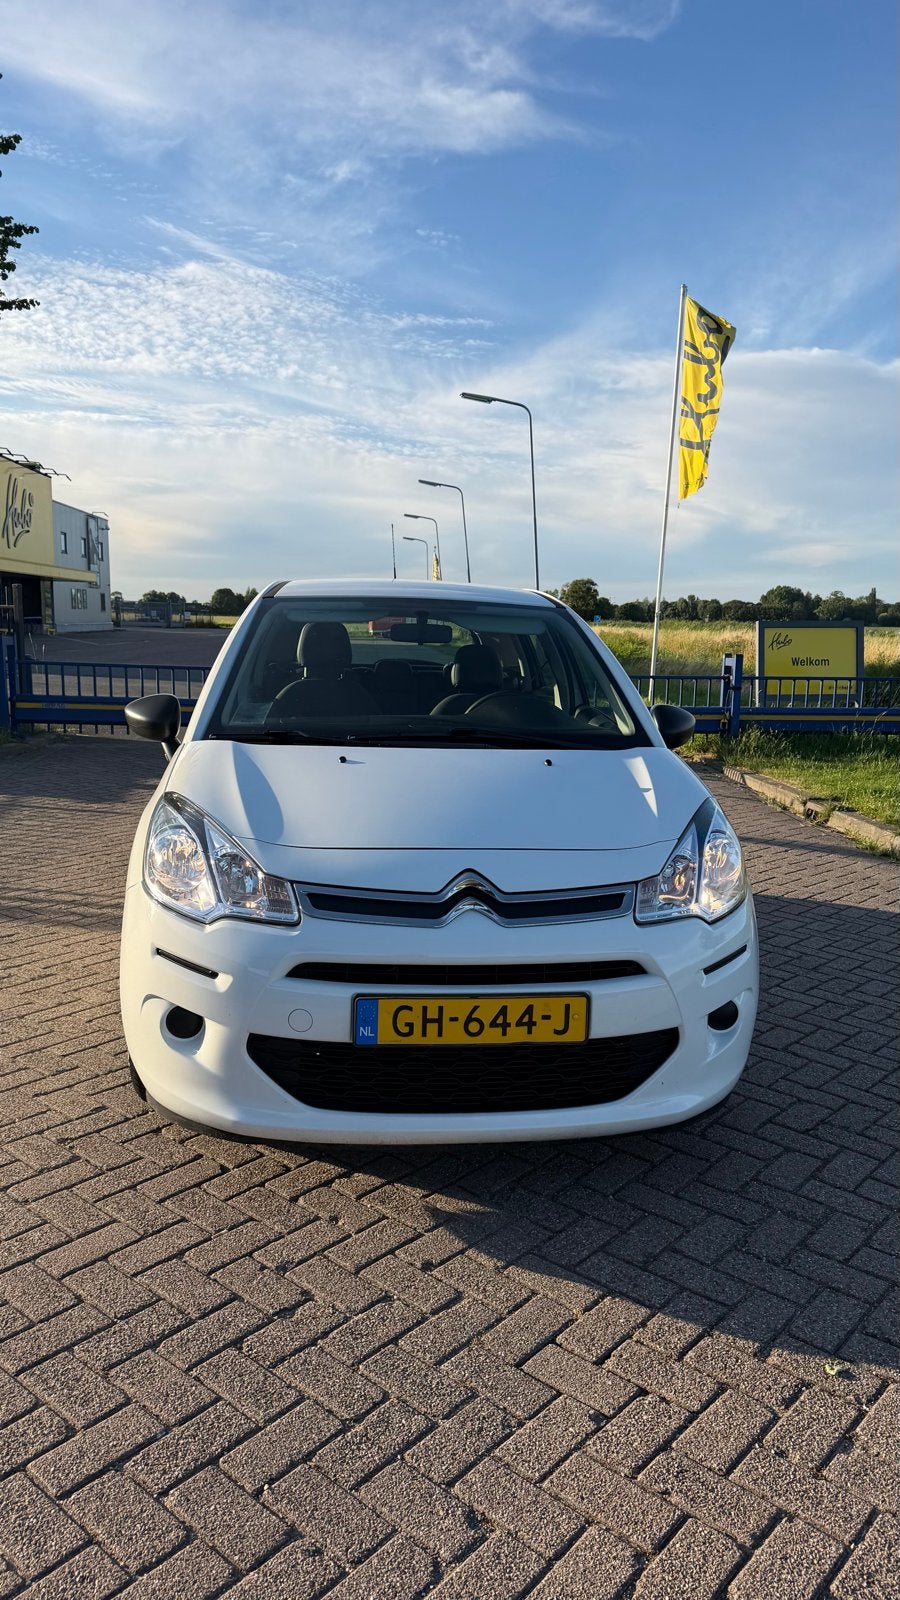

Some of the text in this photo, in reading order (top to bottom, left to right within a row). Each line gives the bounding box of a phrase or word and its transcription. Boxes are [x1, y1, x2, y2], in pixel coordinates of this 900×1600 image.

[768, 632, 793, 651] Hubo
[792, 657, 830, 667] Welkom
[391, 1003, 571, 1038] GH-644-J
[359, 1026, 375, 1038] NL
